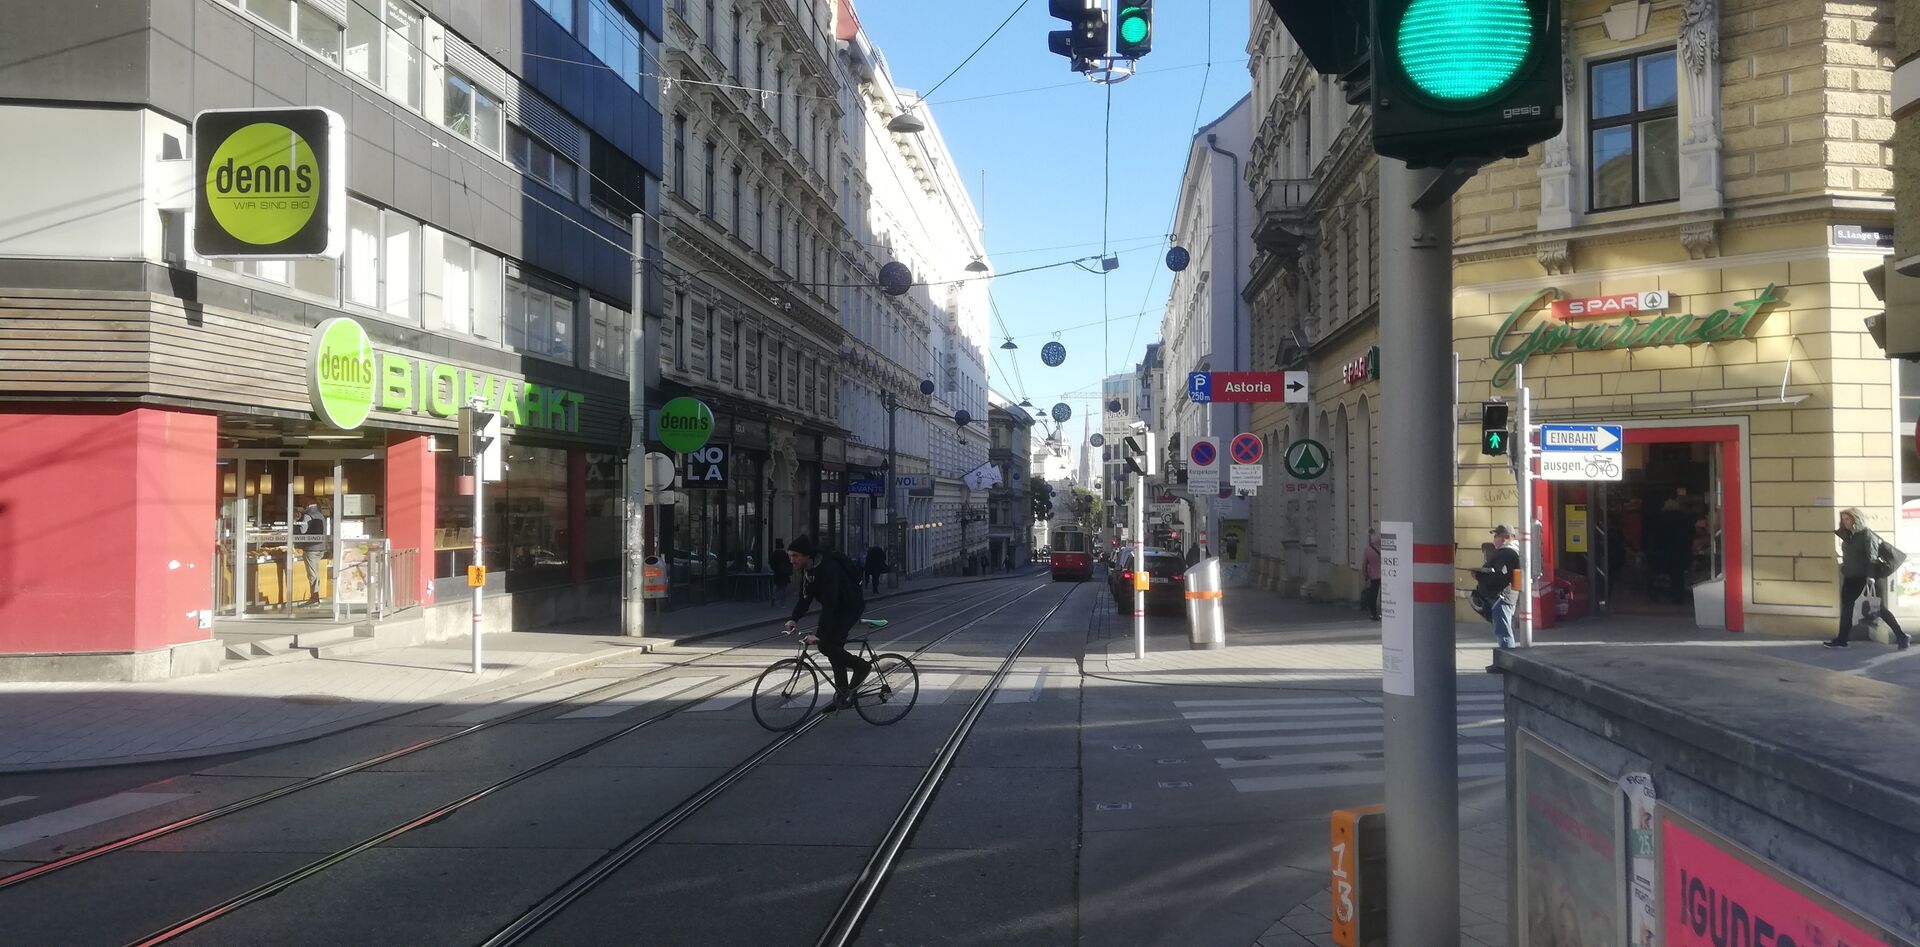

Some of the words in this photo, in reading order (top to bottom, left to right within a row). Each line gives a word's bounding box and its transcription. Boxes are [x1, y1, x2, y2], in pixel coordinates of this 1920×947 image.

[1503, 105, 1540, 118] gesig
[234, 201, 256, 210] WIR
[260, 201, 287, 210] SIND
[291, 201, 310, 209] BIO
[1569, 295, 1638, 314] SPAR
[1492, 282, 1777, 388] Gourmet
[1343, 356, 1369, 385] SPAR
[383, 353, 584, 433] BIOMARKT
[1225, 381, 1272, 393] Astoria
[1550, 431, 1596, 444] EINBAHN
[687, 447, 724, 463] NO
[687, 464, 723, 481] LA
[1543, 460, 1584, 473] ausgen.
[1286, 483, 1329, 492] SPAR
[1680, 868, 1797, 947] IGUDE
